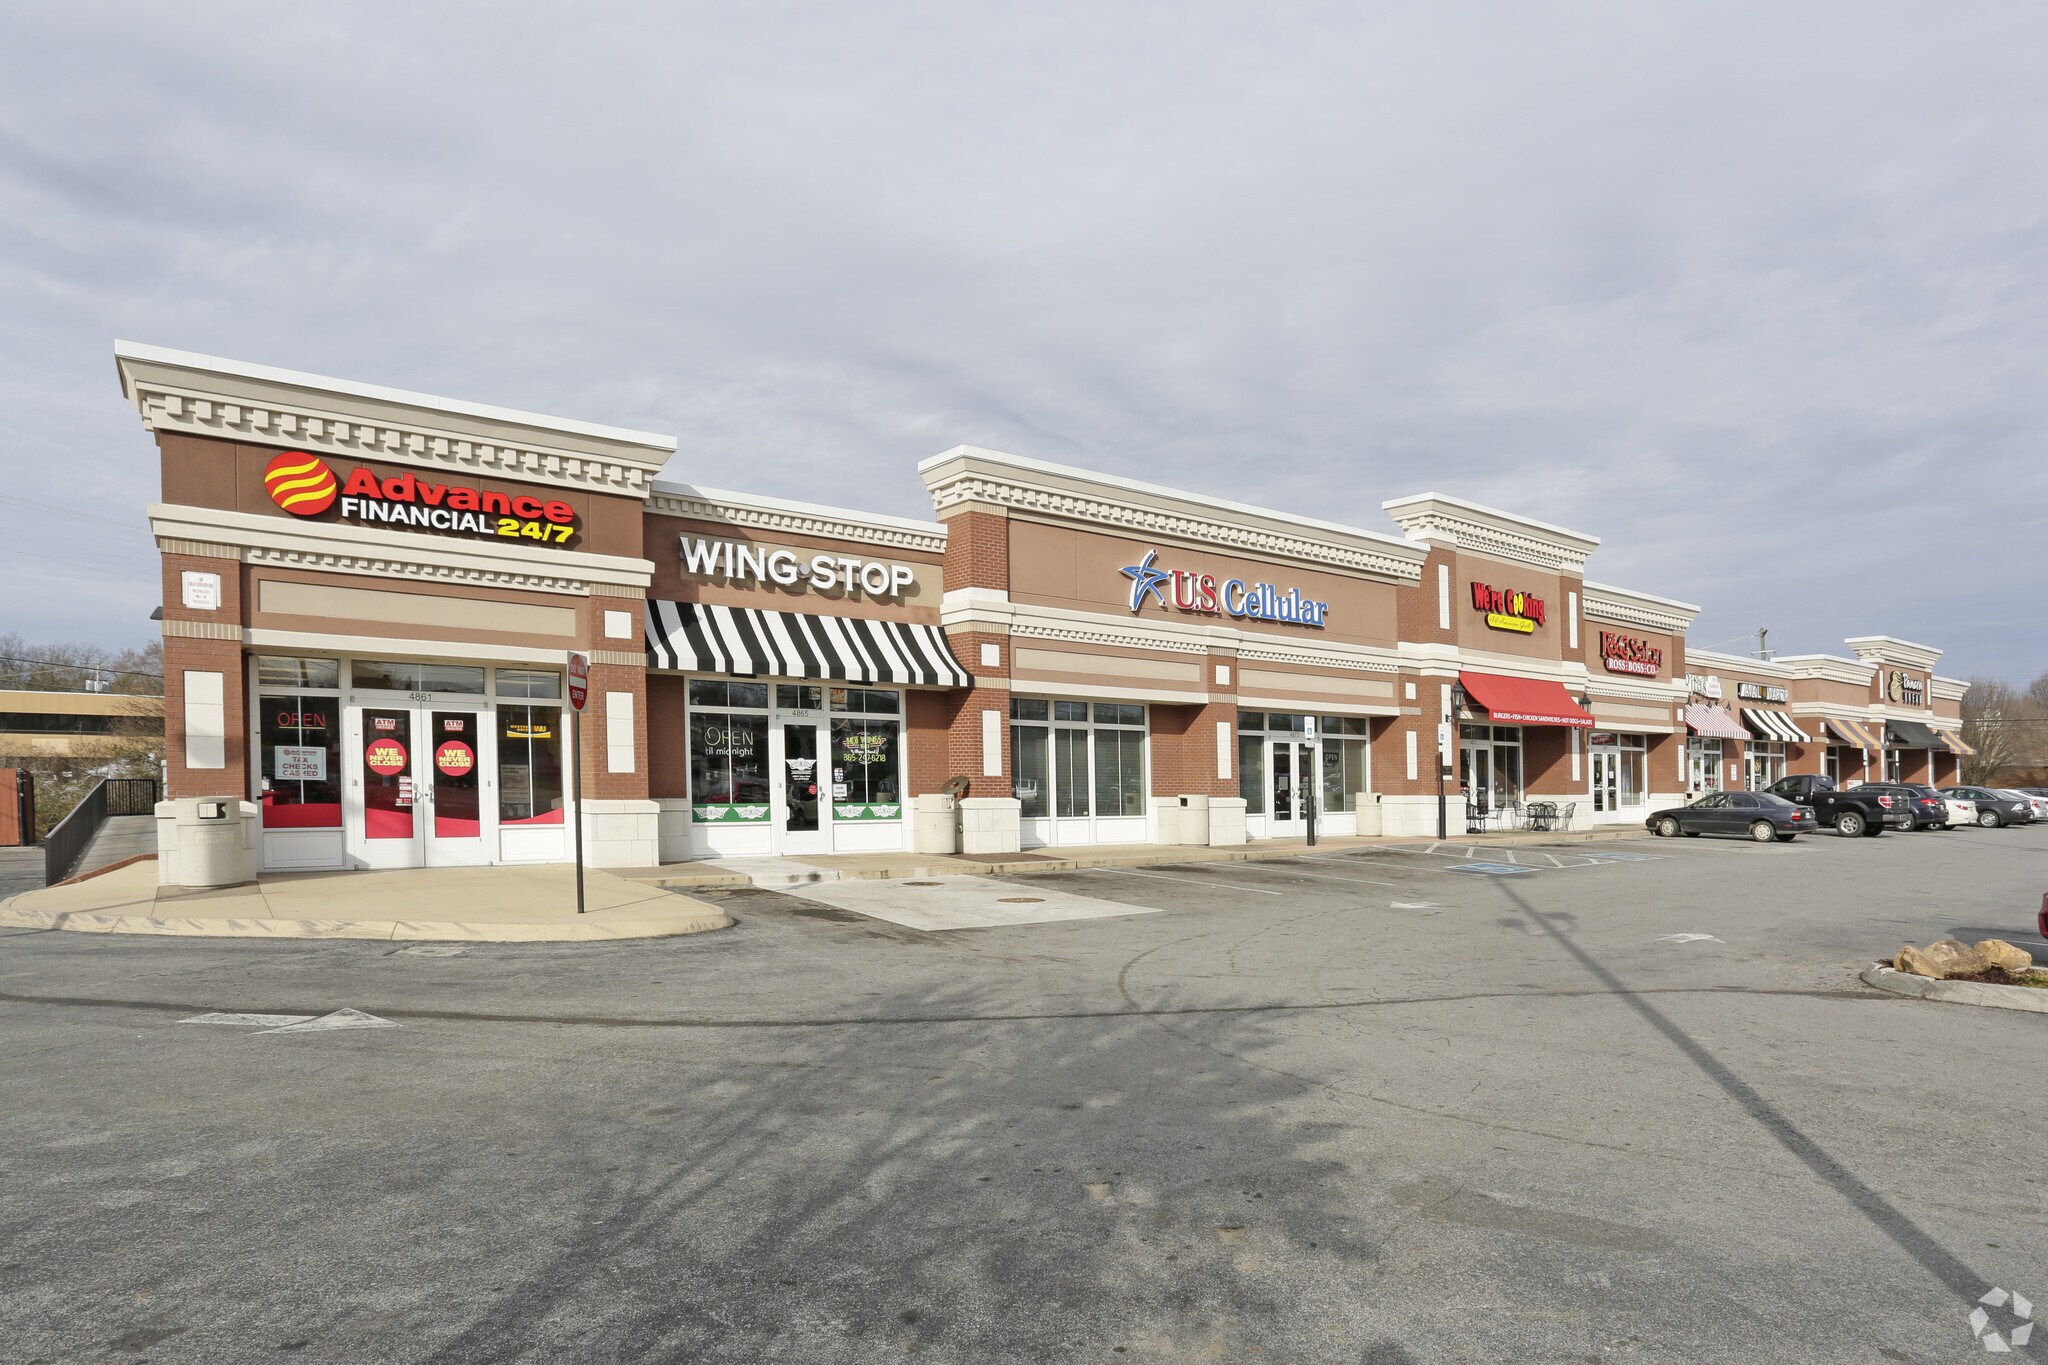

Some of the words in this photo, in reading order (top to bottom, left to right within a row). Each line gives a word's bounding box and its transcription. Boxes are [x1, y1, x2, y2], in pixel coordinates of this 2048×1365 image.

[341, 467, 574, 523] Advance
[342, 498, 494, 535] FINANCIAL
[497, 518, 574, 543] 24/7
[1221, 578, 1328, 627] Cellular
[1471, 581, 1503, 613] We're
[1505, 588, 1546, 625] Cooking
[570, 664, 577, 673] DO
[409, 692, 432, 701] 4861
[572, 690, 584, 699] ENTER
[792, 709, 809, 717] 4865
[277, 712, 327, 727] OPEN
[705, 727, 754, 745] OPEN
[374, 748, 398, 756] WE
[444, 749, 466, 757] WE
